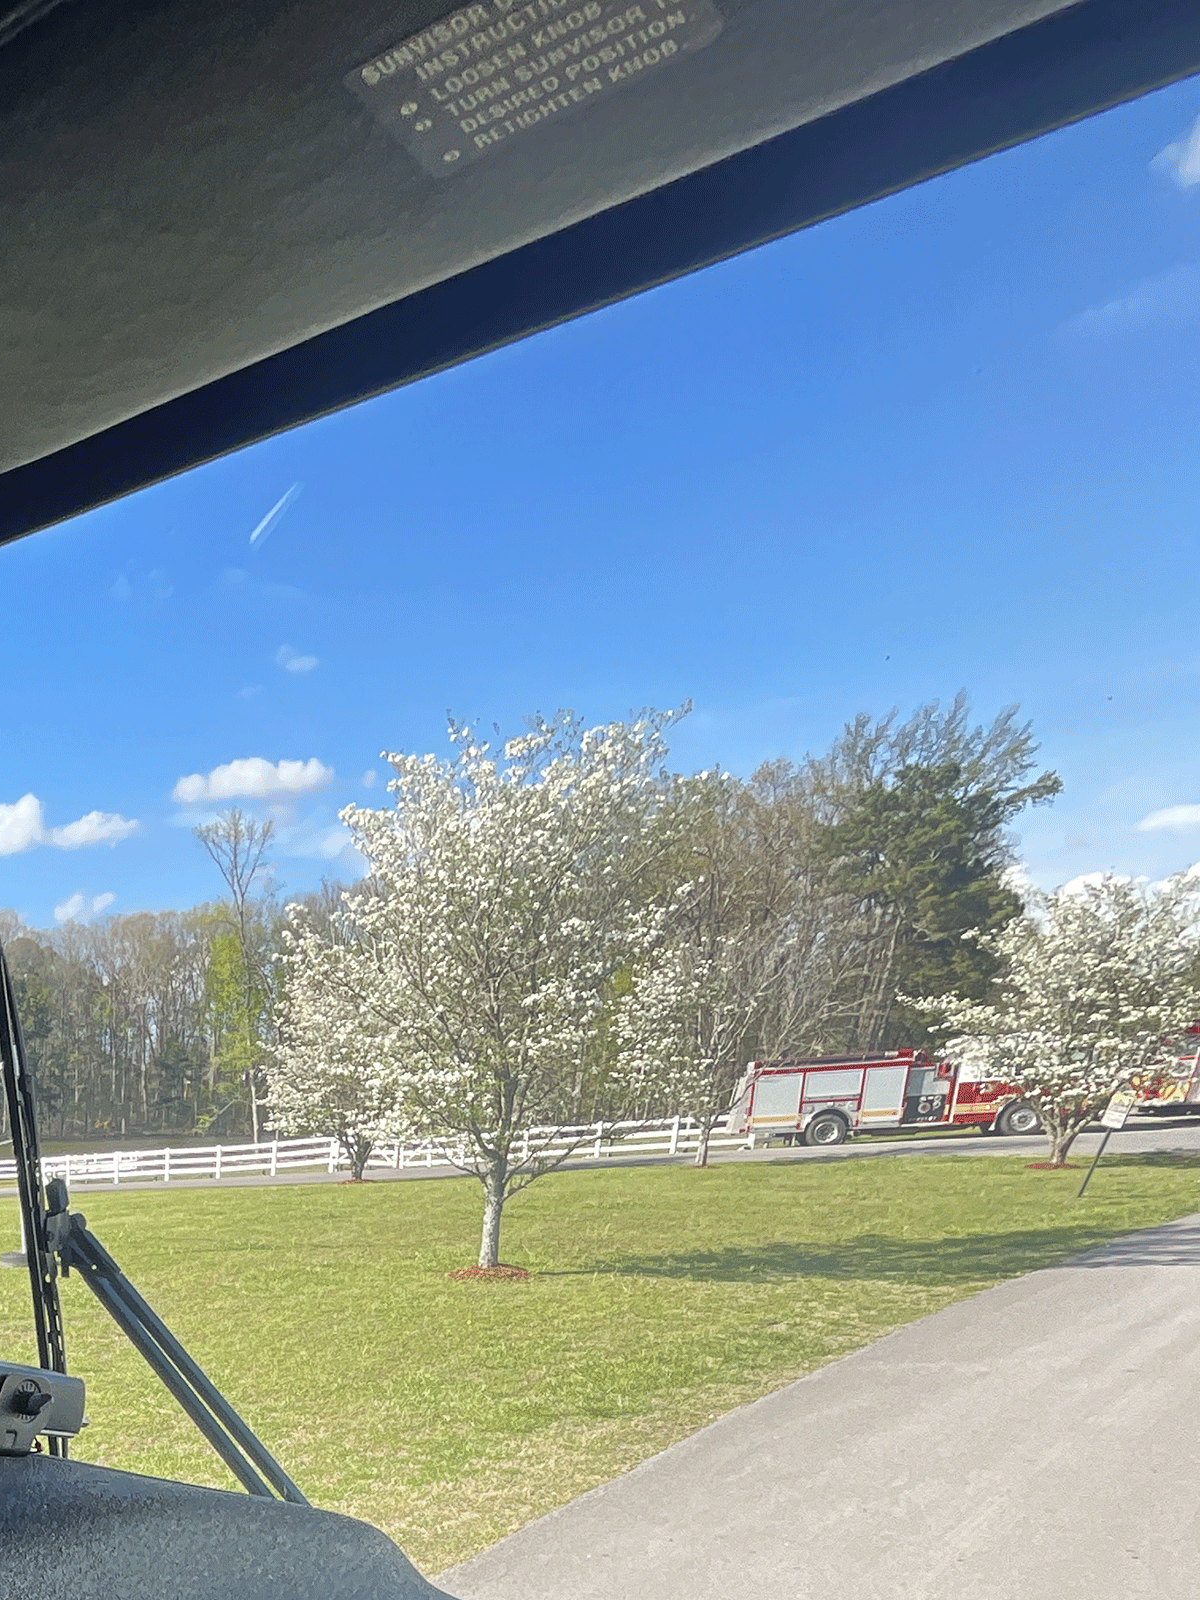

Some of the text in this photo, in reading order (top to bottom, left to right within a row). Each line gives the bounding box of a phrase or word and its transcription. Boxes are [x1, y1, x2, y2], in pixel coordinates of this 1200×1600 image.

[361, 4, 489, 86] SUNVISOR
[431, 1, 602, 102] LOOSEN KNOB
[444, 76, 510, 118] TURN
[514, 5, 646, 83] SUNVISOR
[460, 10, 686, 134] DESIRED POSITION
[474, 39, 678, 149] RETIGHTEN KNOB
